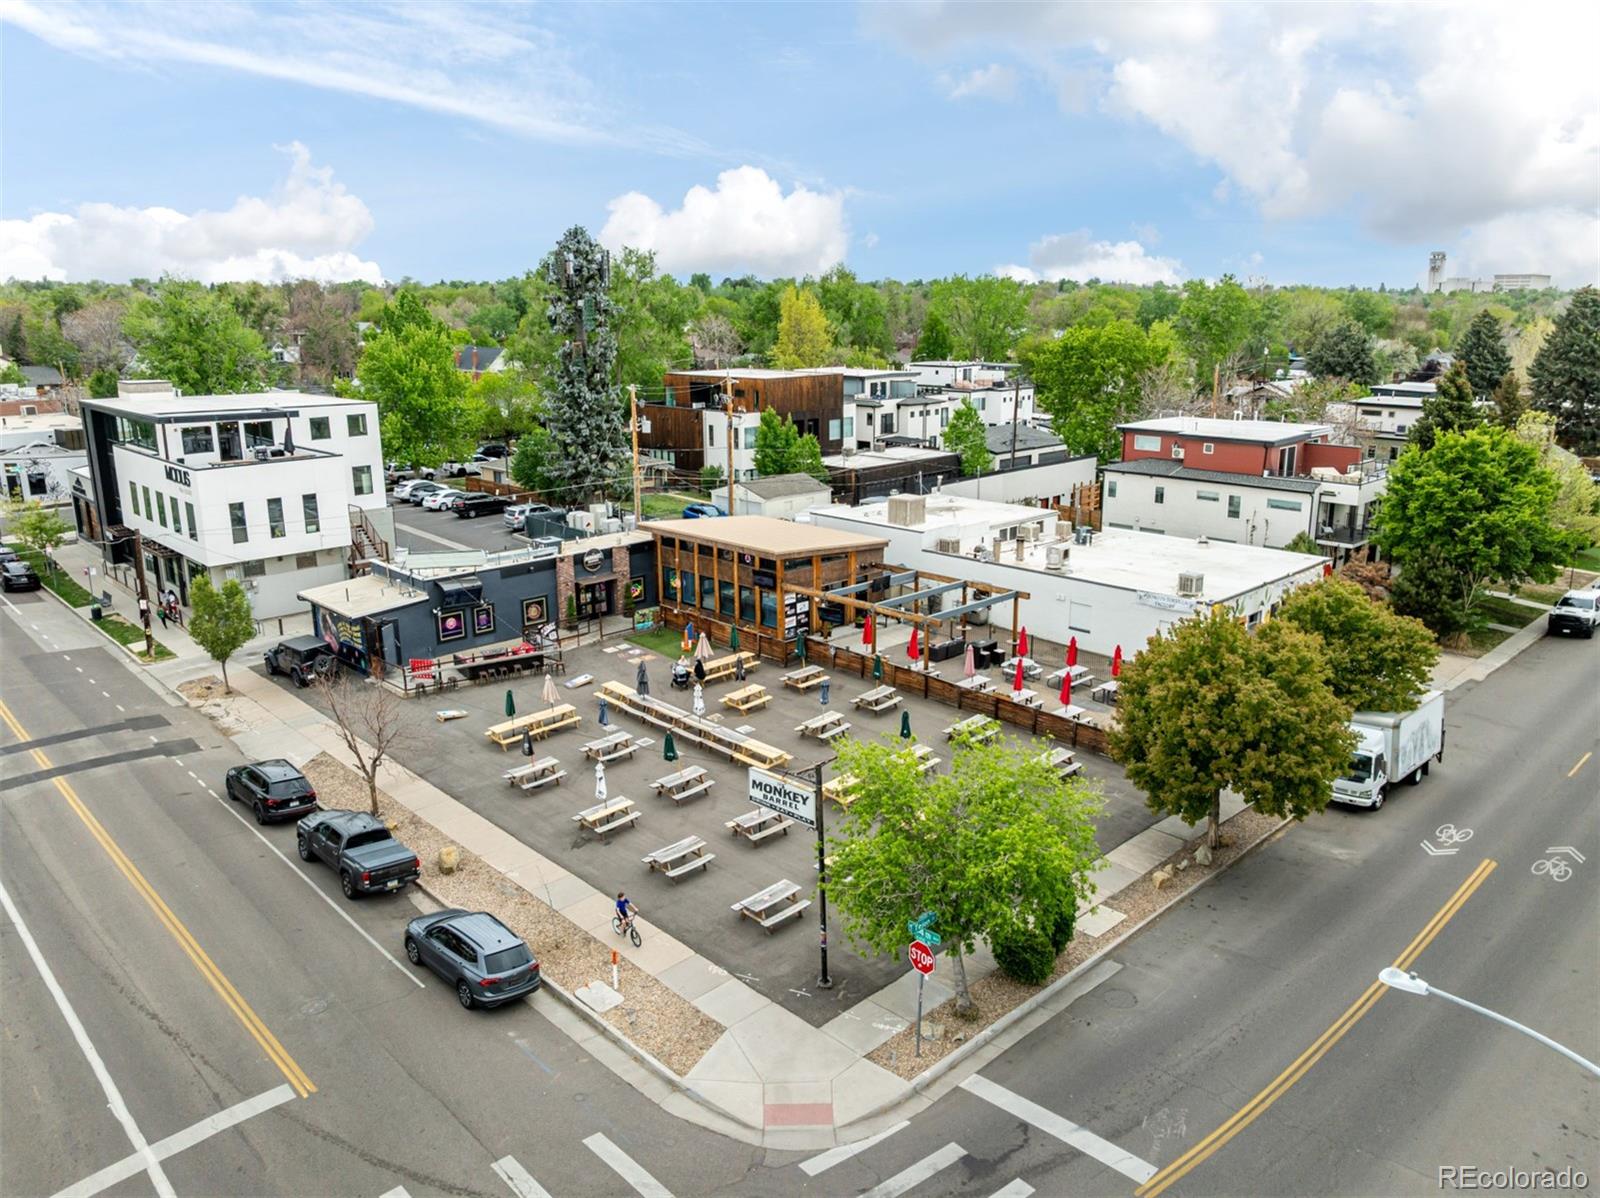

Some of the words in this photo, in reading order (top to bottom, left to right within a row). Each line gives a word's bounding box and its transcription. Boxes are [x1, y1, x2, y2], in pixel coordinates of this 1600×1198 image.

[752, 780, 809, 805] MONKEY
[763, 793, 800, 811] BARREL
[911, 947, 933, 967] STOP
